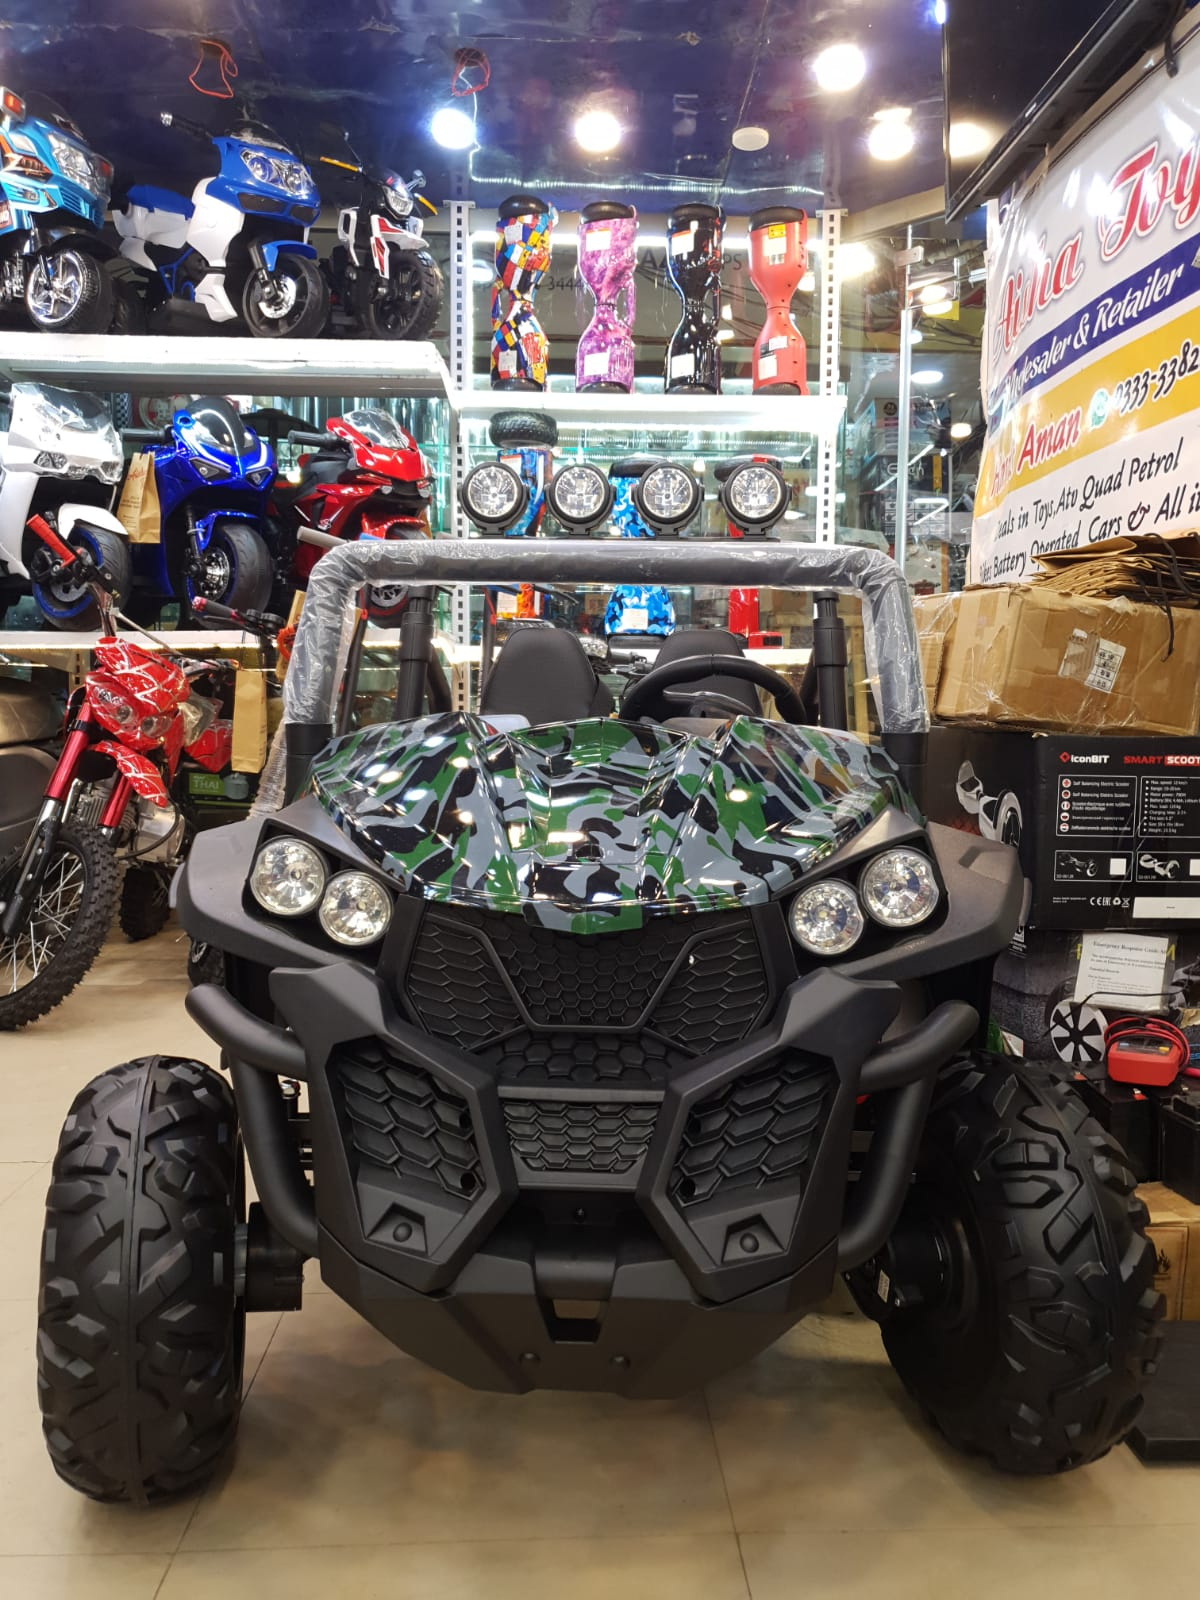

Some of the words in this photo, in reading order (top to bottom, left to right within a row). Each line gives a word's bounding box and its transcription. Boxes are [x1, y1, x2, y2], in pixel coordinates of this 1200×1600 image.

[1073, 312, 1090, 350] &
[1093, 263, 1185, 338] Retailer
[1017, 409, 1081, 472] Aman
[1018, 507, 1029, 530] in
[1079, 459, 1125, 511] Quad
[1128, 436, 1184, 487] Petrol
[993, 555, 1027, 577] Battery
[1089, 515, 1122, 542] Cars
[1154, 484, 1187, 524] All
[1070, 754, 1110, 764] iconBIT
[1123, 755, 1163, 765] SMART
